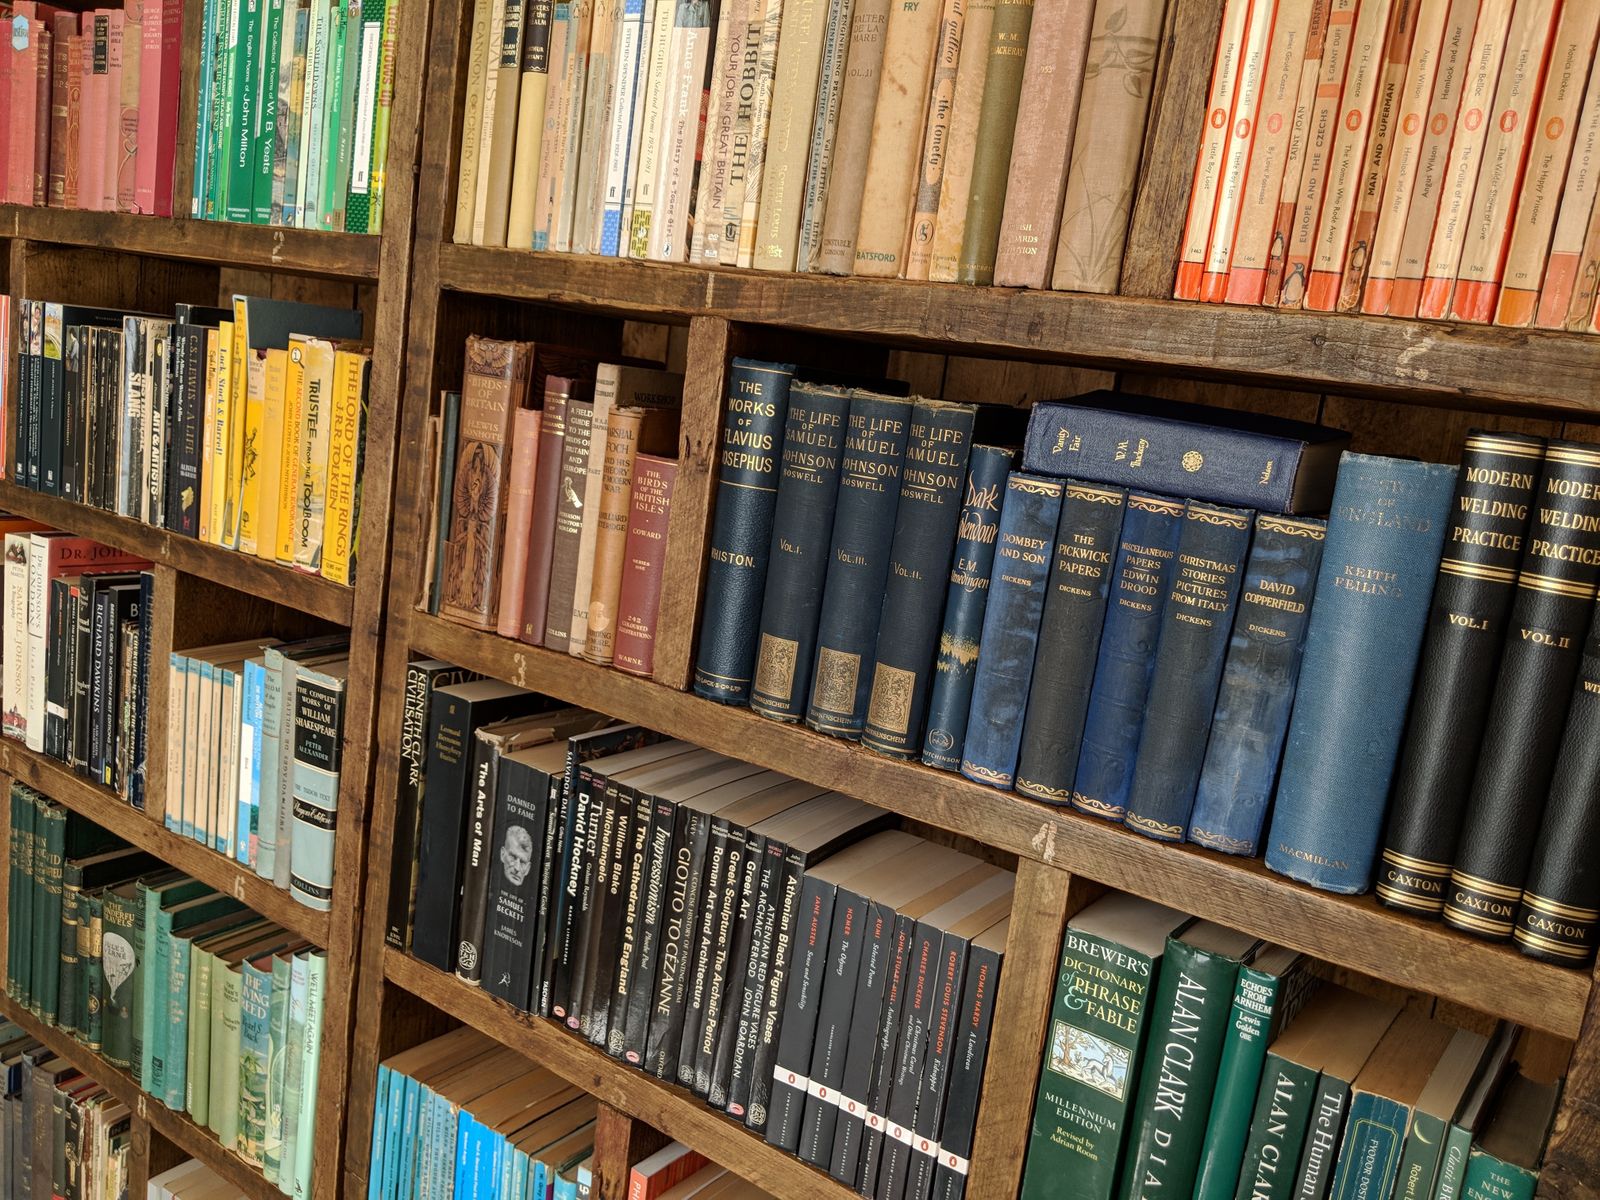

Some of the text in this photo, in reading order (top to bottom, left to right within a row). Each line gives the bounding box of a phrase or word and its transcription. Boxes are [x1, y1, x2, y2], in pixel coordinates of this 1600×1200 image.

[903, 1, 920, 12] FRY
[383, 40, 395, 85] grows
[679, 30, 698, 117] Anne Frank
[379, 90, 392, 106] up
[730, 24, 761, 186] THE HOBBIT
[712, 34, 741, 209] YOUR JOB IN GREAT BRITAIN
[262, 100, 275, 174] W. B. Yeats
[1289, 106, 1305, 161] SAINT JOAN
[1368, 83, 1395, 196] MAN AND SUPERMAN
[239, 129, 248, 168] Milton
[1300, 109, 1328, 243] EUROPE AND THE CZECHS
[856, 251, 896, 263] BATSFORD
[128, 372, 142, 418] SLANG
[739, 381, 762, 395] THE
[729, 398, 776, 416] WORKS
[738, 419, 752, 427] OF
[810, 411, 840, 428] LIFE
[724, 430, 772, 450] FLAVIUS
[786, 430, 838, 448] SAMUEL
[1053, 427, 1070, 454] Vanity
[1069, 435, 1081, 452] Fair
[151, 410, 161, 495] ART ARTISTS
[336, 359, 359, 557] THE LORD OF THE RINGS
[301, 378, 321, 548] TRUSTEE TOOLROOM
[1259, 460, 1274, 485] Nelson
[329, 443, 340, 510] TOLKIEN
[637, 476, 668, 489] BIRDS
[783, 468, 823, 484] BOSWELL
[1466, 466, 1534, 490] MODERN
[634, 492, 670, 507] BRITISH
[965, 470, 999, 512] Dark
[636, 502, 664, 515] ISLES
[1460, 496, 1528, 520] WELDING
[632, 528, 661, 540] COWARD
[1002, 533, 1047, 549] DOMBEY
[1074, 534, 1094, 546] THE
[1452, 526, 1521, 551] PRACTICE
[1000, 548, 1045, 564] AND SON
[1059, 544, 1110, 564] PICKWICK
[1121, 541, 1175, 560] MISCELLANEOUS
[1059, 560, 1101, 578] PAPERS
[1126, 555, 1161, 569] PAPERS
[1179, 554, 1237, 574] CHRISTMAS
[1001, 575, 1031, 586] DICKENS
[1122, 569, 1160, 584] EDWIN
[1182, 567, 1226, 585] STORIES
[1344, 564, 1398, 582] KEITH
[1059, 584, 1092, 597] DICKENS
[1120, 580, 1157, 596] DROOD
[1176, 580, 1228, 599] PICTURES
[1260, 579, 1296, 596] DAVID
[1119, 598, 1152, 612] DICKENS
[1171, 592, 1229, 613] FROM ITALY
[1244, 592, 1305, 614] COPPERFIELD
[1176, 612, 1212, 627] DICKENS
[1249, 623, 1286, 638] DICKENS
[93, 604, 104, 713] RICHARD DAWKINS
[618, 653, 643, 666] WARNE
[309, 690, 337, 705] COMPLETE
[301, 706, 331, 724] WILLIAM
[402, 670, 418, 759] CIVILISATION
[295, 718, 337, 737] SHAKESPEARE
[408, 673, 426, 787] KENNETH CLARK
[507, 794, 536, 811] DAMNED
[507, 803, 535, 821] TO FAME
[471, 762, 488, 867] The Arts of Man
[586, 801, 603, 857] Turner
[567, 792, 590, 897] David Hockney
[598, 807, 615, 883] Michelangelo
[1279, 842, 1349, 871] MACMILLAN
[1387, 870, 1442, 893] CAXTON
[496, 905, 524, 923] BECKETT
[499, 896, 524, 914] SAMUEL
[1455, 891, 1513, 917] CAXTON
[808, 895, 821, 947] JANE AUSTEN
[658, 847, 691, 1017] GIOTTO TO CÉZANNE
[764, 875, 798, 1044] Athenian Black Figure Vases
[1067, 935, 1149, 977] BREWER'S
[1064, 956, 1146, 995] DICTIONARY
[972, 964, 988, 1028] THOMAS HARDY
[1061, 970, 1142, 1015] of PHRASE
[1240, 979, 1273, 997] ECHOES
[1242, 989, 1266, 1003] FROM
[1064, 986, 1137, 1034] & FABLE
[1235, 996, 1273, 1015] ARNHEM
[1236, 1021, 1260, 1036] Golden
[1239, 1012, 1261, 1027] Lewis
[1154, 972, 1207, 1120] ALAN CLARK
[1045, 1092, 1117, 1131] MILLENNIUM
[1267, 1072, 1296, 1139] ALAN
[1056, 1107, 1102, 1134] EDITION
[1050, 1135, 1098, 1161] Adrian Room
[1056, 1126, 1095, 1150] Revised by
[1302, 1093, 1342, 1195] The Human
[1481, 1181, 1514, 1200] NEW
